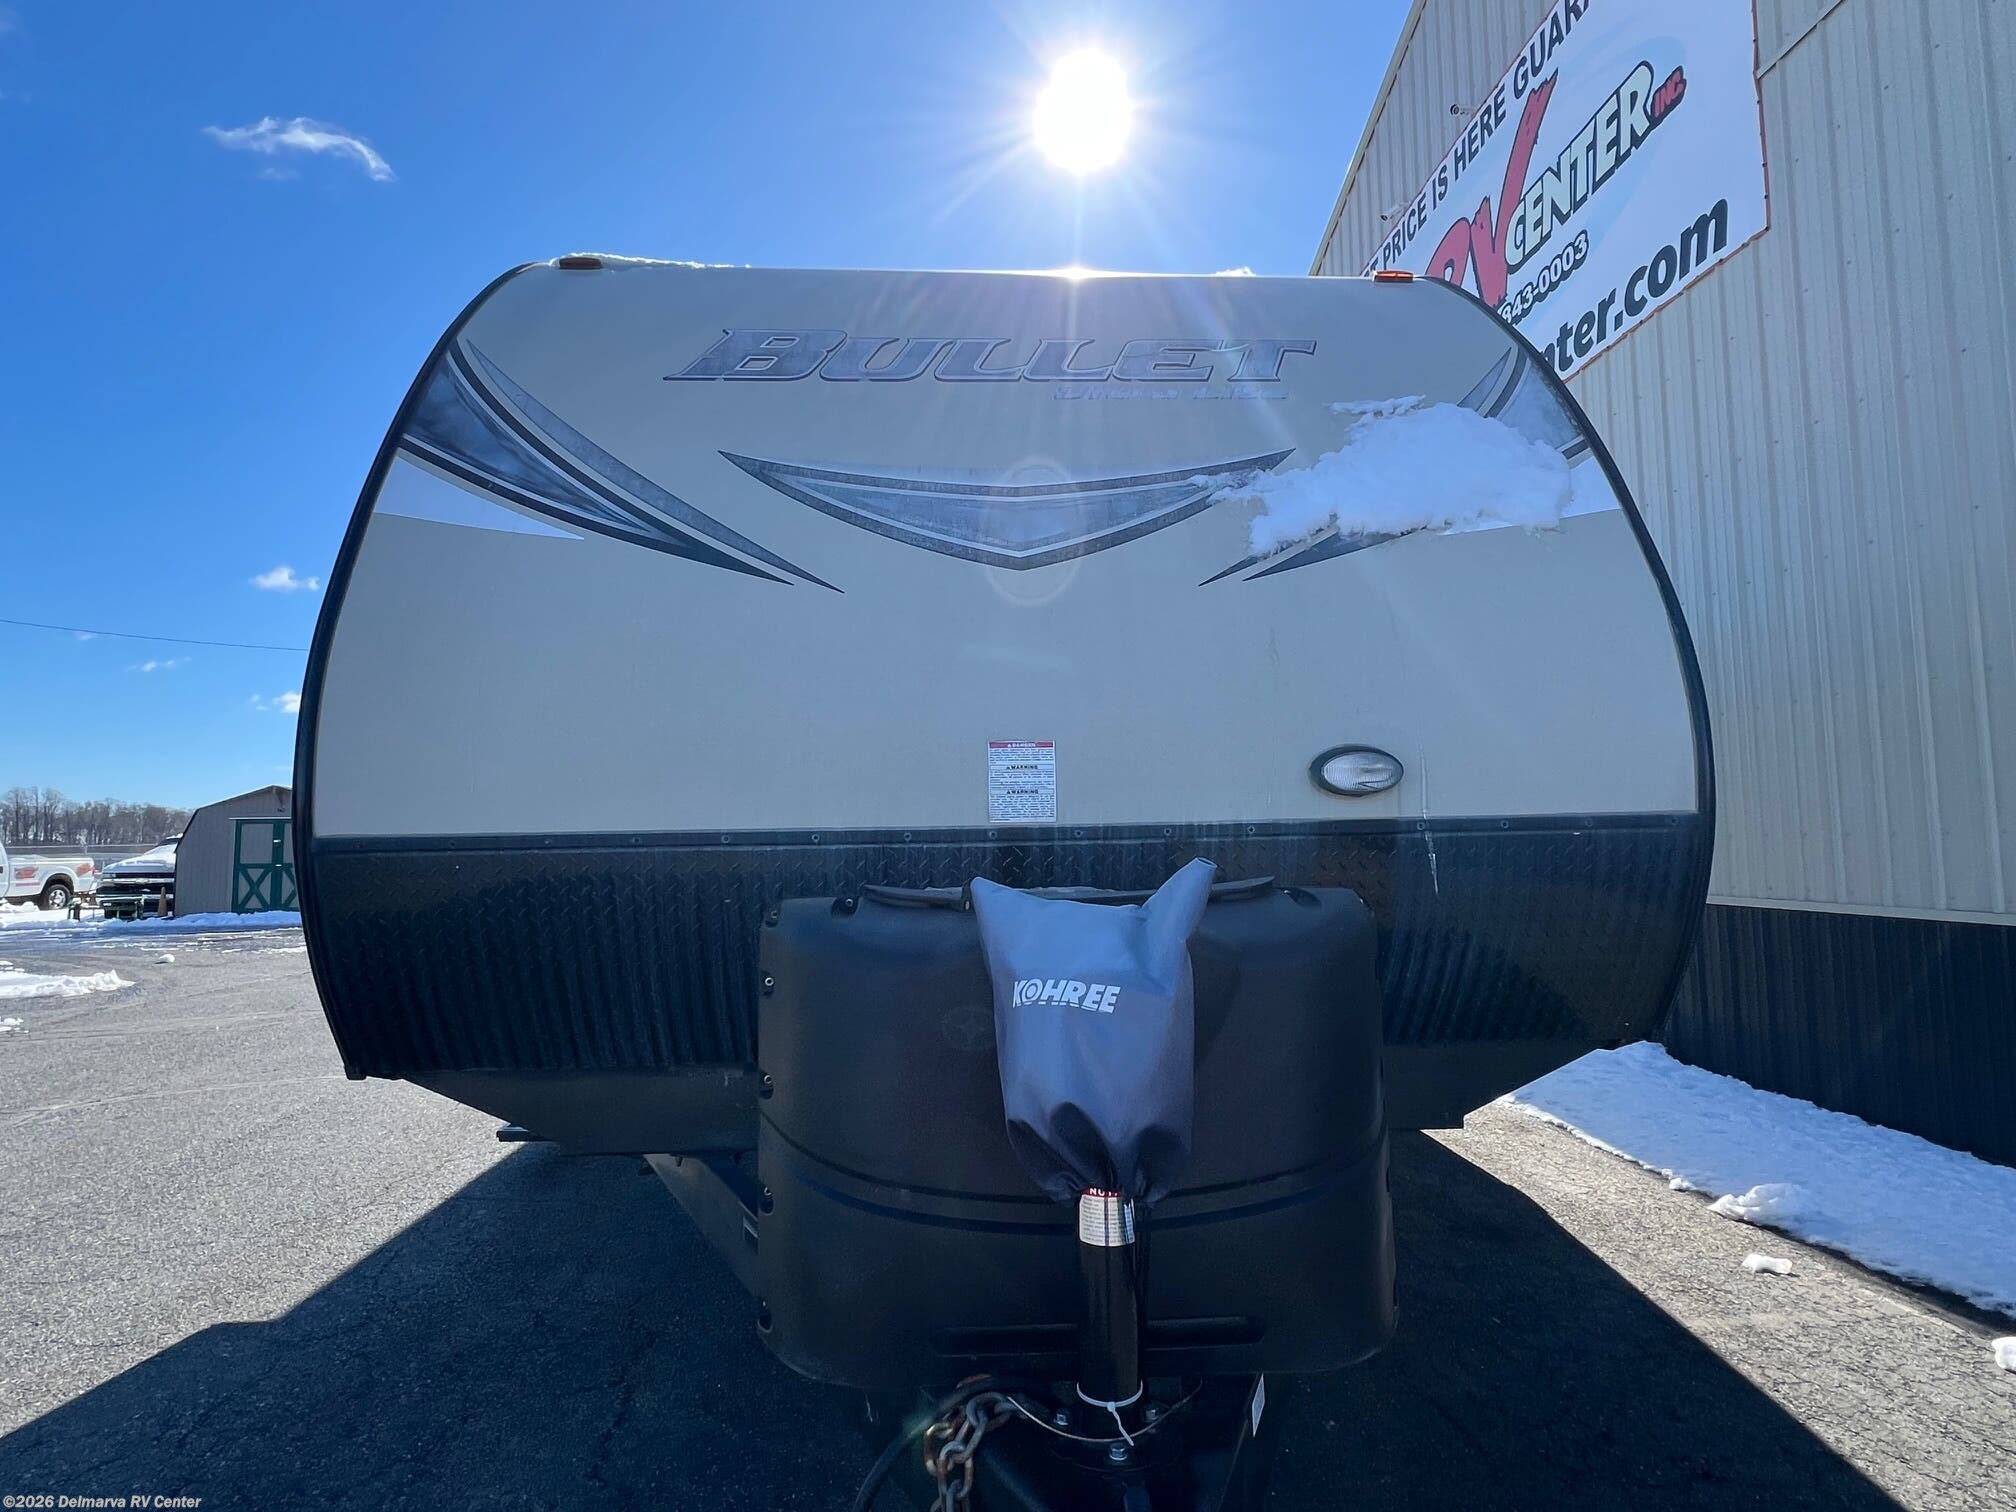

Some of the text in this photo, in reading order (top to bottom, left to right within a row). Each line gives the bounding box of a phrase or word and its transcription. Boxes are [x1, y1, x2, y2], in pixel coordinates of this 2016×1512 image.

[1382, 0, 1590, 271] PRICE IS HERE GUAR
[1424, 67, 1559, 308] RV
[1504, 60, 1654, 274] CENTER
[663, 329, 1317, 381] BULLET
[1012, 979, 1121, 1014] KOHREE
